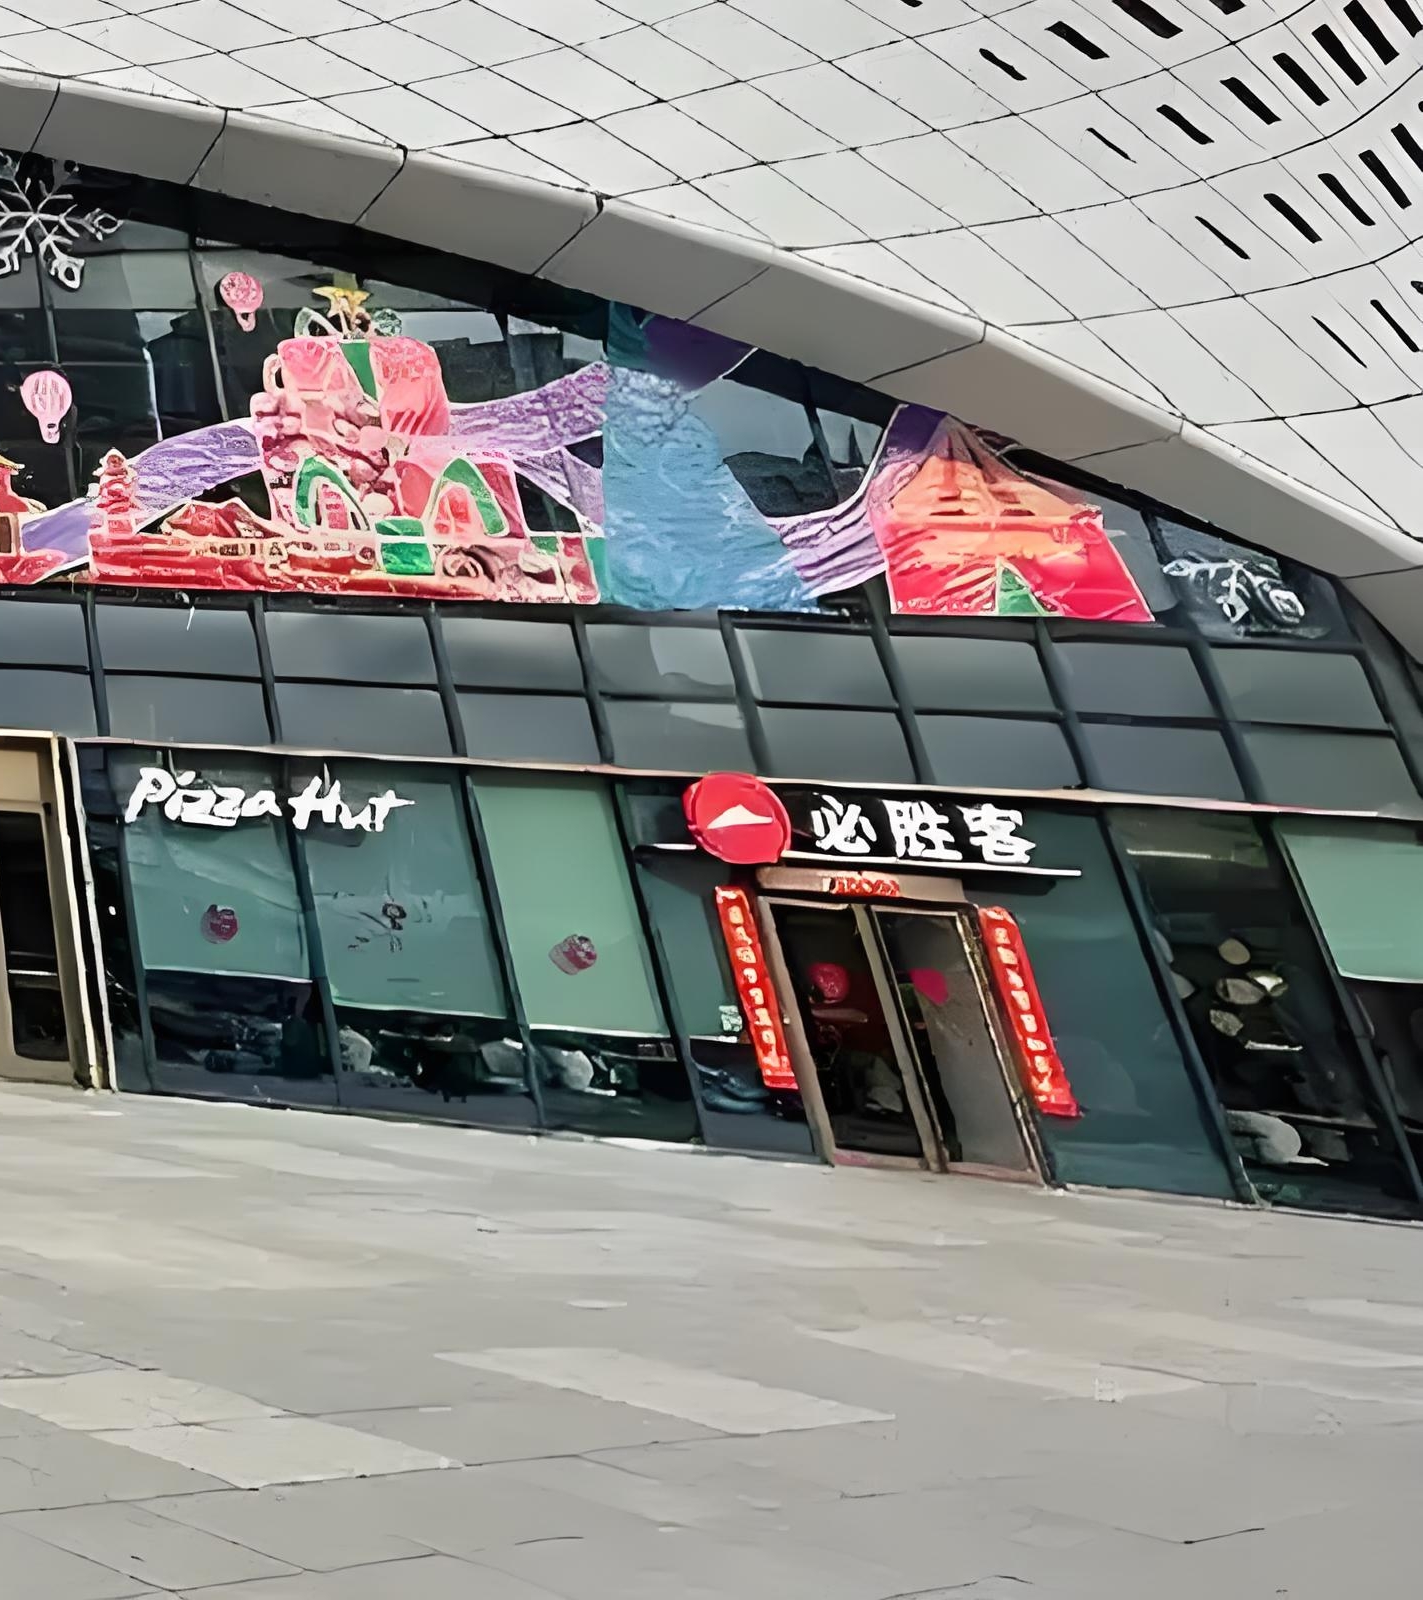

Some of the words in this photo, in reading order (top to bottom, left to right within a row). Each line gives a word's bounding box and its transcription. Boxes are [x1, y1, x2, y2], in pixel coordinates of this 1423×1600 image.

[124, 767, 283, 827] Pizza
[288, 774, 416, 833] Hut
[810, 793, 1037, 864] 必胜客
